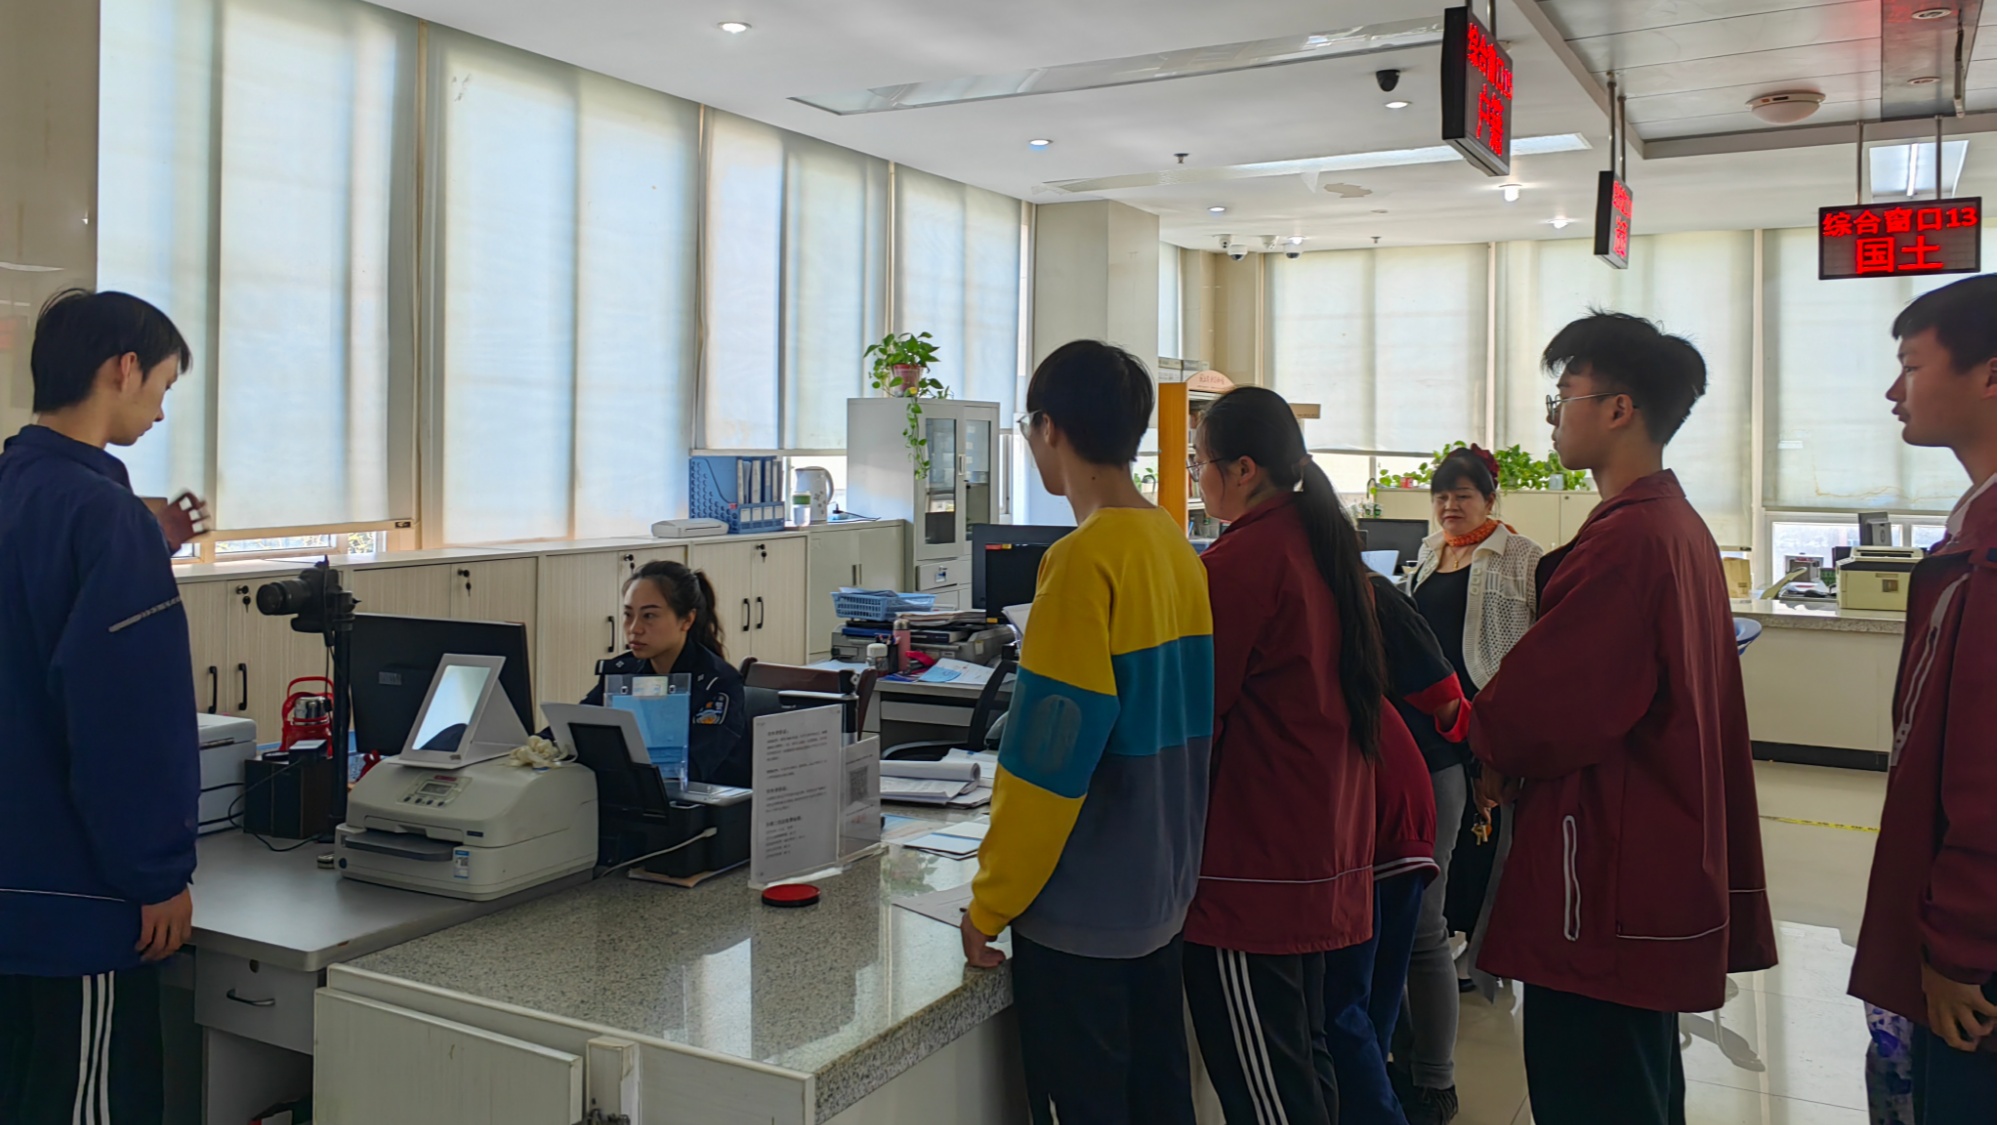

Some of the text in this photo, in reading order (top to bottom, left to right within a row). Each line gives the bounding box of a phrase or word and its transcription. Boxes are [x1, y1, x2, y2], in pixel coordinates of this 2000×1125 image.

[1822, 207, 1978, 237] 综合窗口13
[1856, 235, 1944, 274] 国土
